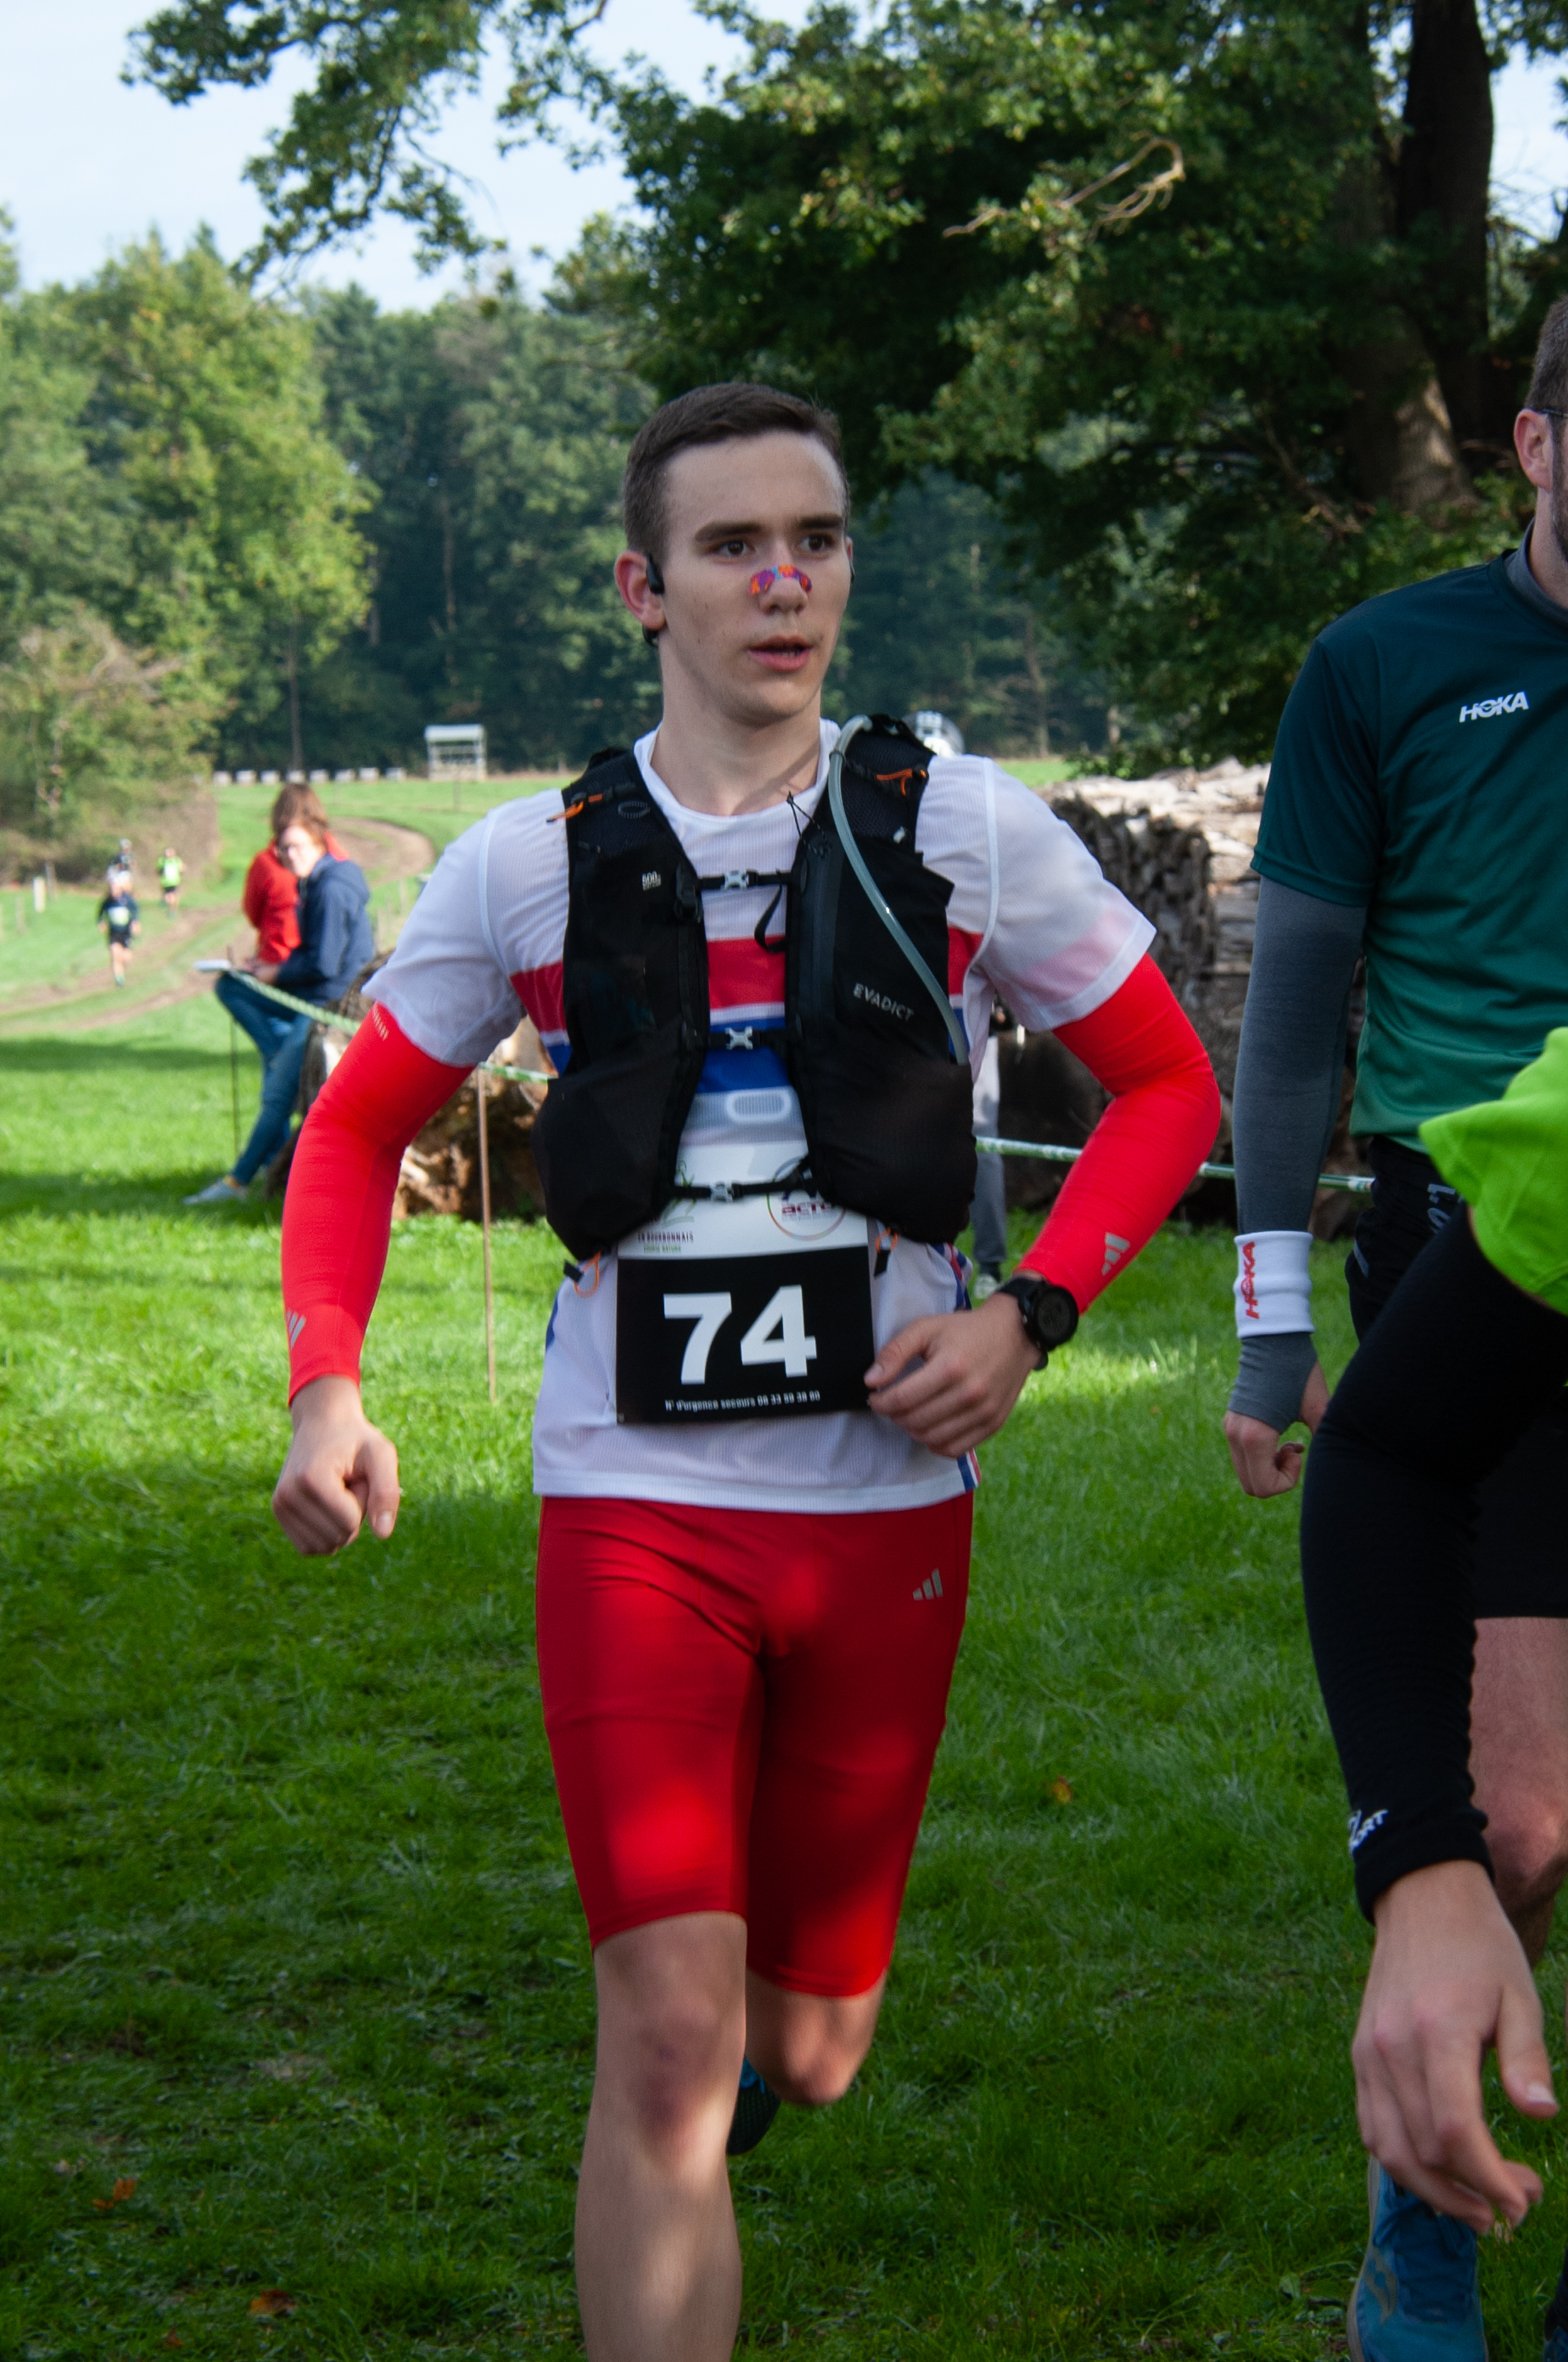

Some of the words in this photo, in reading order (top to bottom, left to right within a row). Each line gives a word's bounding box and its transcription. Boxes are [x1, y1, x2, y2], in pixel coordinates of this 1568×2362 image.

[1459, 691, 1529, 723] HOKA
[853, 982, 914, 1021] EVADICT
[1240, 1241, 1260, 1320] HOKA
[663, 1284, 817, 1385] 74
